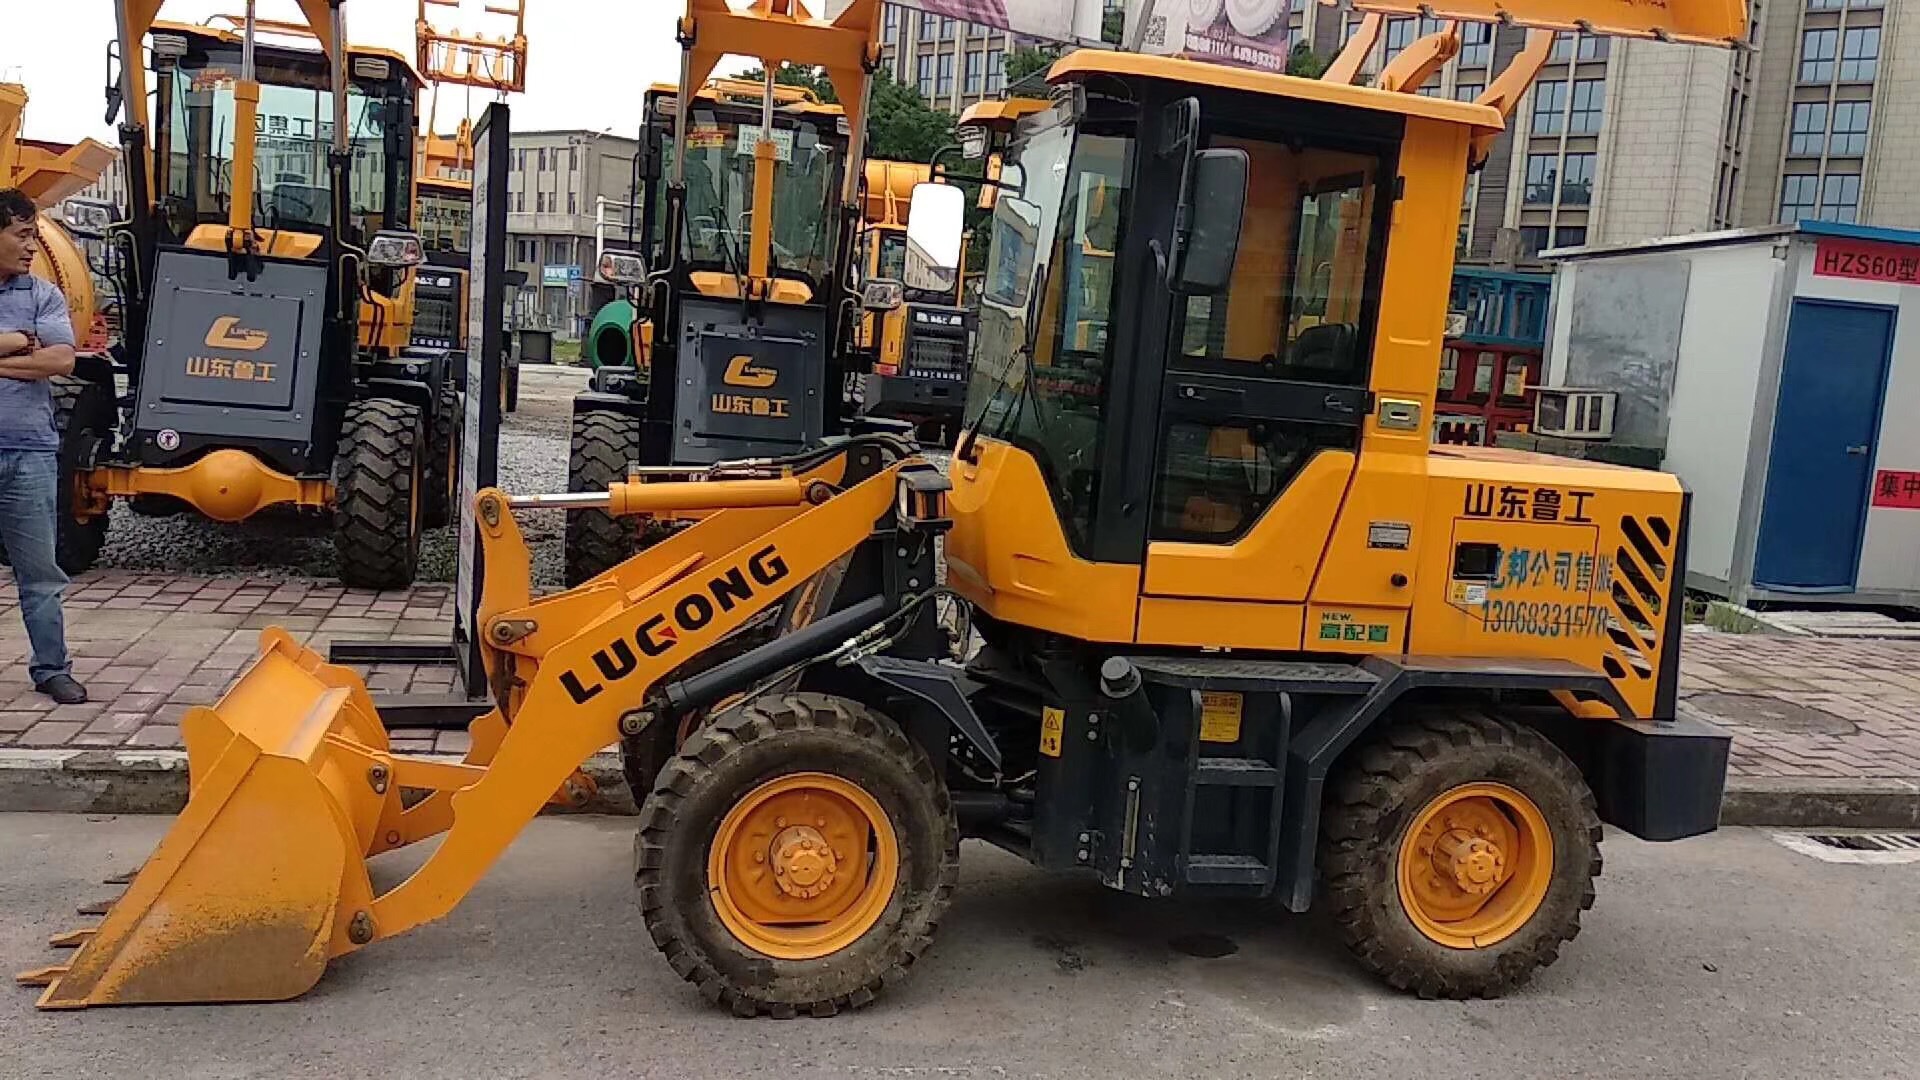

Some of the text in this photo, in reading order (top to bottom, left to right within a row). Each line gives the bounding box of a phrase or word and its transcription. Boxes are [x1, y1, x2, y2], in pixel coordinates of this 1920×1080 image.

[1823, 249, 1918, 280] HZS60型
[1464, 484, 1595, 523] 山东鲁工
